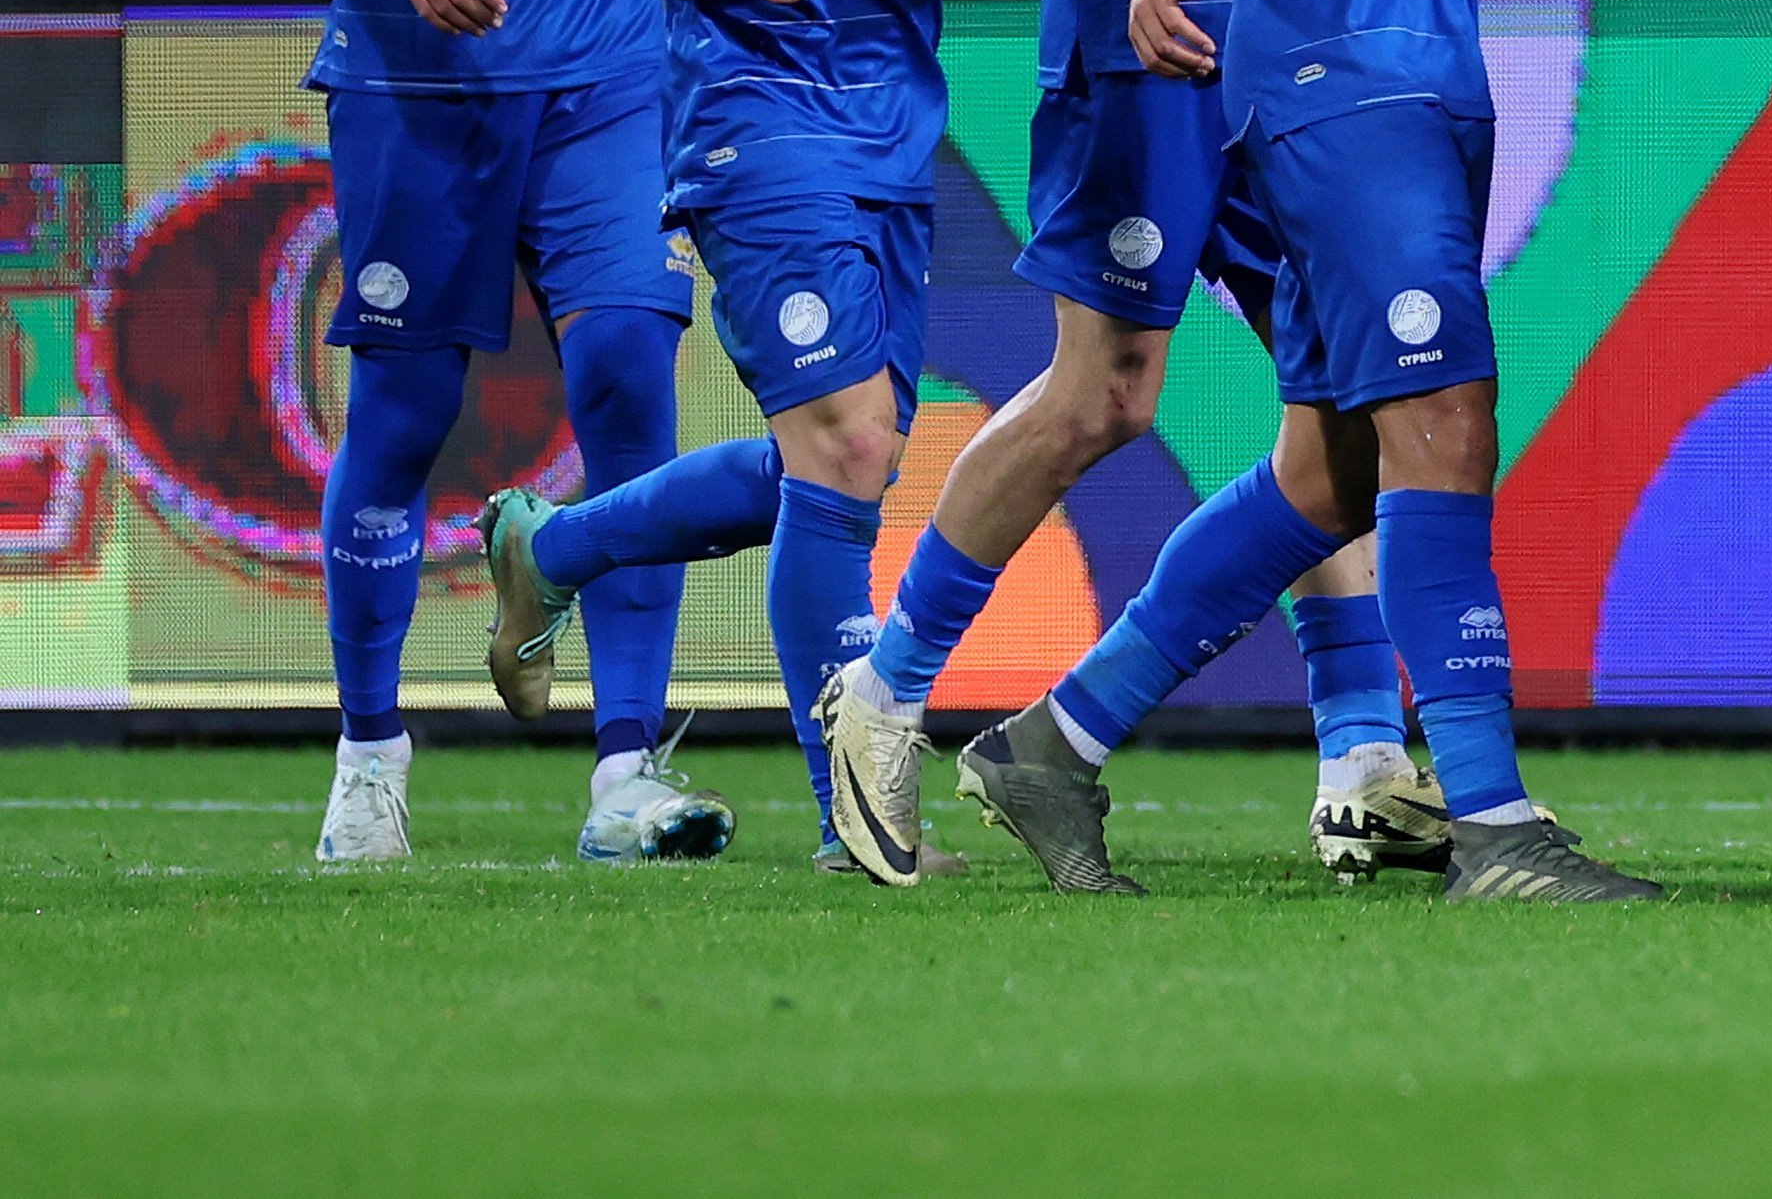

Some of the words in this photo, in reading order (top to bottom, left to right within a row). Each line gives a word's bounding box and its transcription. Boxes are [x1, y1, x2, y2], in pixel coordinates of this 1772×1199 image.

[1102, 272, 1148, 292] CYPRUS
[359, 313, 403, 328] CYPRUS
[793, 345, 836, 369] CYPRUS
[1398, 350, 1443, 367] CYPRUS
